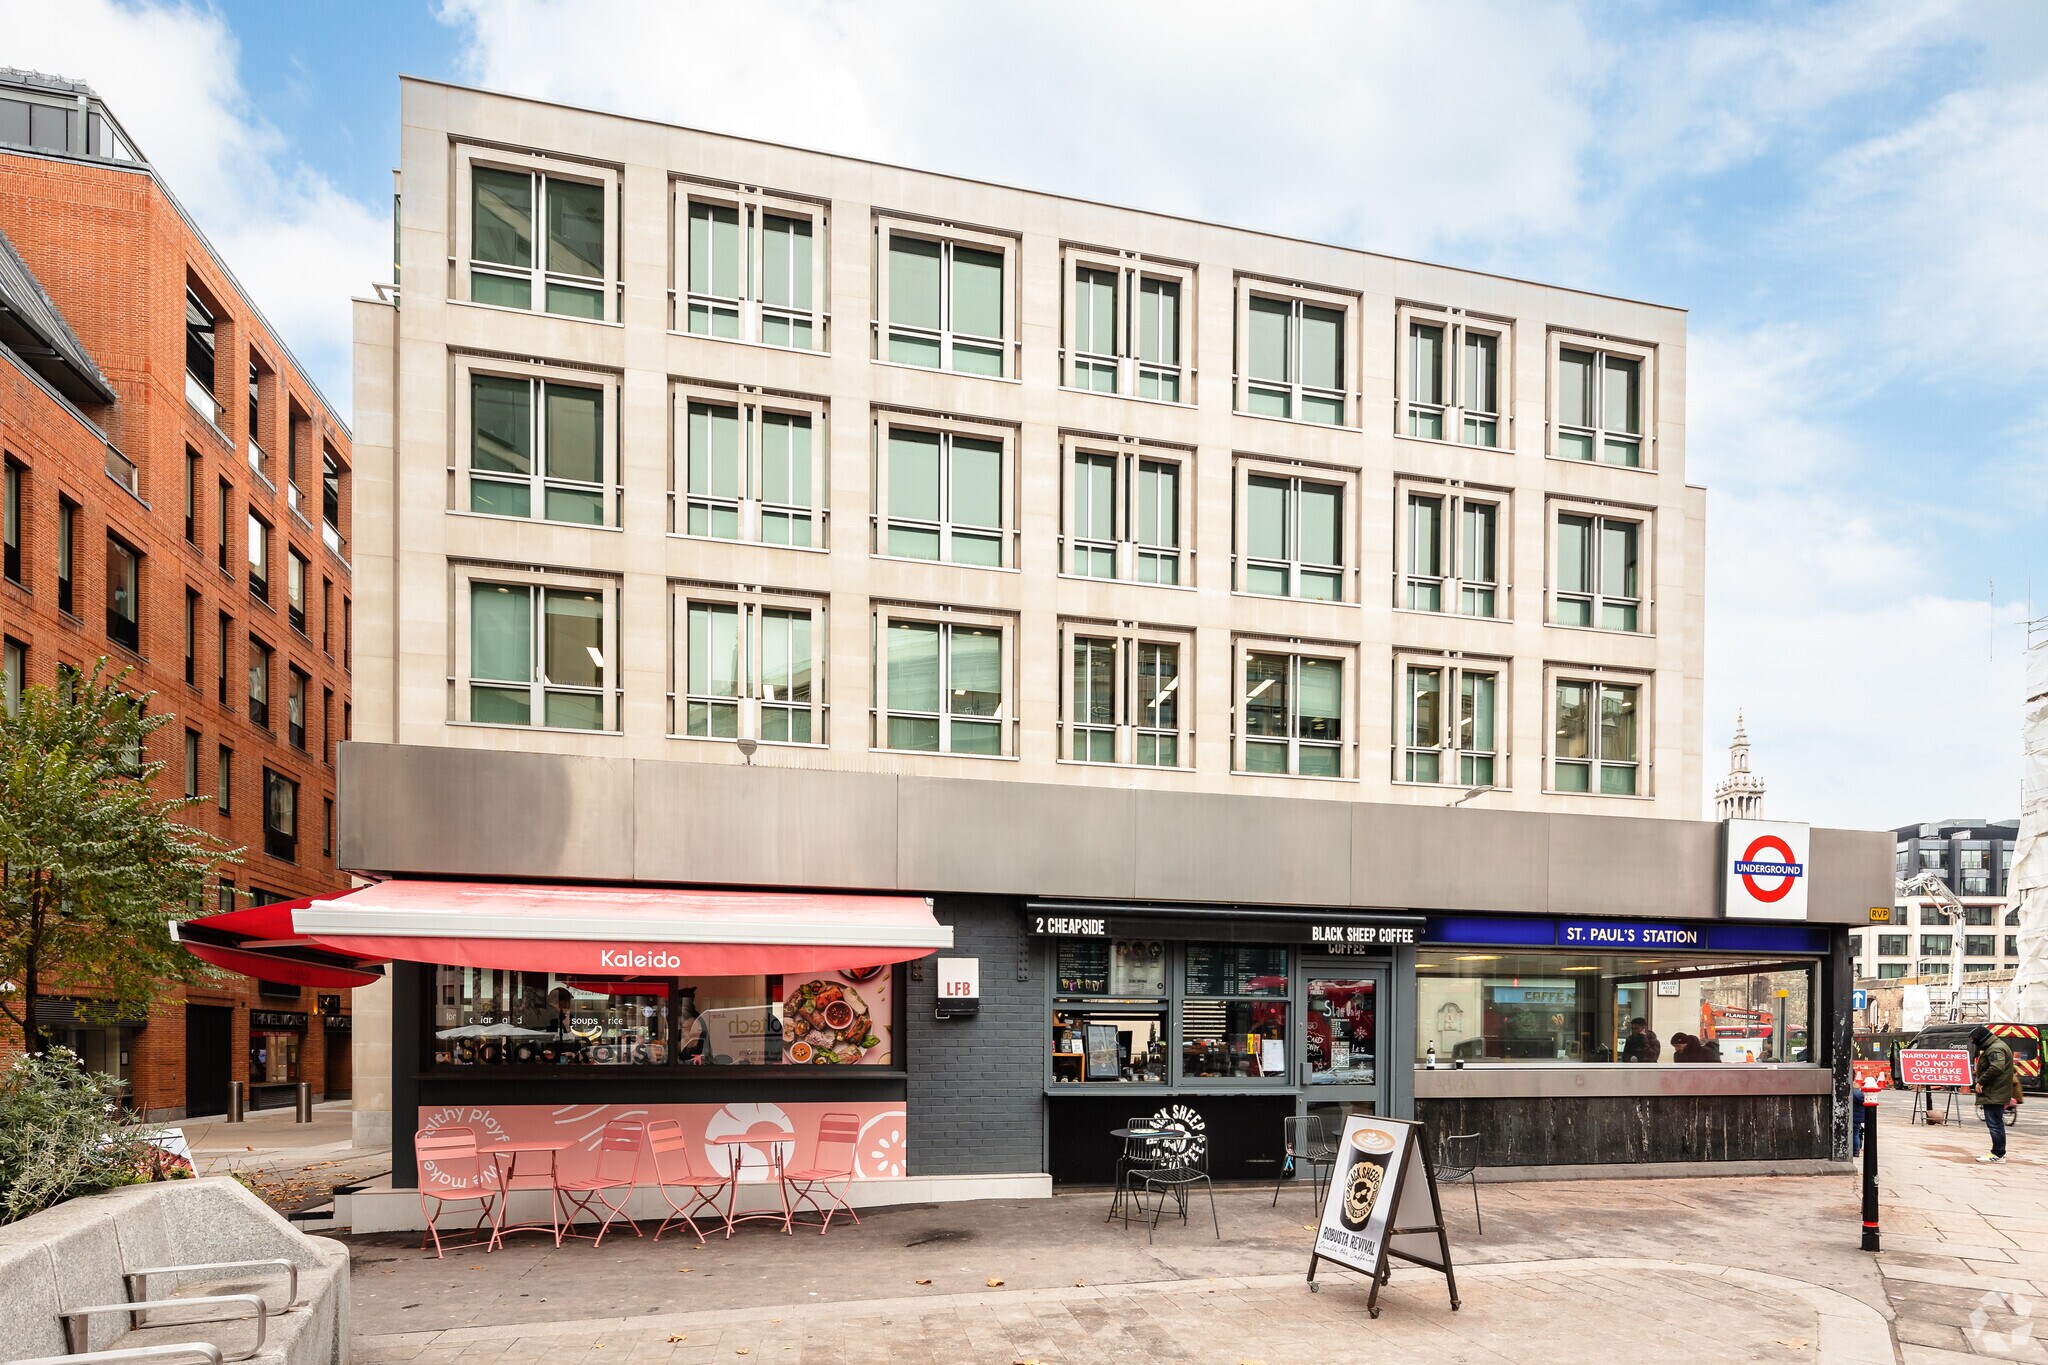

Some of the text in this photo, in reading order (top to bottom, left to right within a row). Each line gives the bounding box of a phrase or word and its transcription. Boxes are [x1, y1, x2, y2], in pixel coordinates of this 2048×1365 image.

[1736, 863, 1801, 875] UNDERGROUND
[1871, 909, 1889, 919] RVP
[1036, 917, 1105, 935] 2 CHEAPSIDE
[1312, 926, 1414, 943] BLACK SHEEP COFFEE
[1567, 927, 1697, 943] ST. PAUL'S STATION
[602, 949, 681, 968] Kaleido
[946, 981, 971, 996] LFB
[571, 1017, 598, 1026] soups
[608, 1016, 623, 1025] rice
[1910, 1067, 1962, 1075] OVERTAKE
[1912, 1074, 1961, 1082] CYCLISTS
[1172, 1104, 1206, 1131] SHEEP
[423, 1160, 467, 1189] make
[1346, 1166, 1380, 1191] BLACK SHEEP
[1322, 1226, 1376, 1256] ROBUSTA REVIVAL
